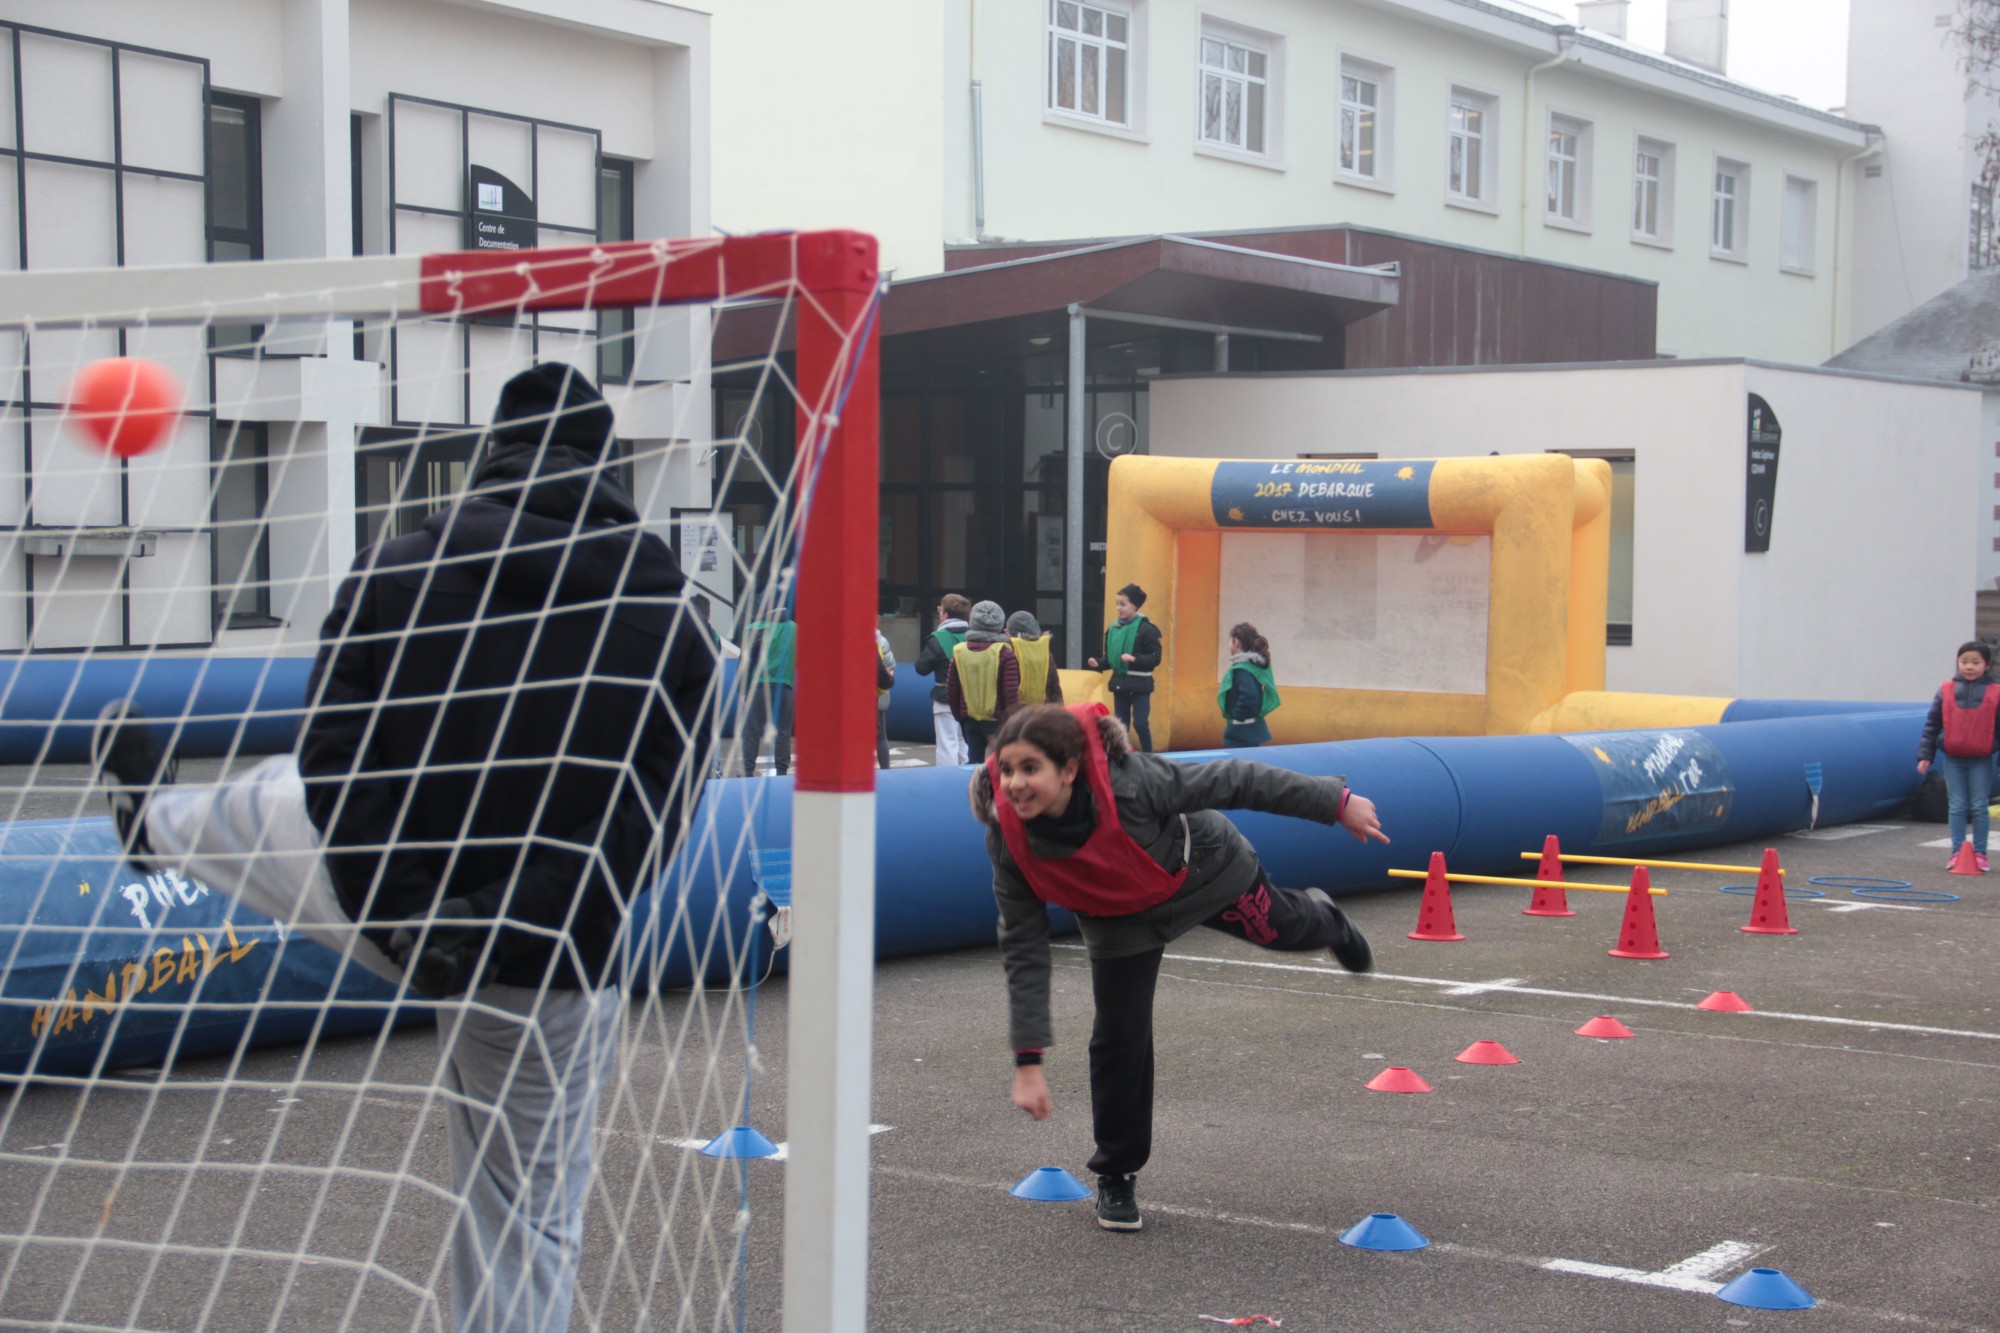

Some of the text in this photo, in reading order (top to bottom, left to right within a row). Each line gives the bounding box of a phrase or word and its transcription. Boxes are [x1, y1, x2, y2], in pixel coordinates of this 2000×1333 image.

[478, 221, 505, 235] Centre de
[478, 236, 519, 250] Documentation
[1270, 462, 1367, 474] LE MONDIAL
[1253, 481, 1375, 499] 2017 DEBARQUE
[1271, 509, 1311, 523] CHEZ
[31, 919, 261, 1038] HANDBALL
